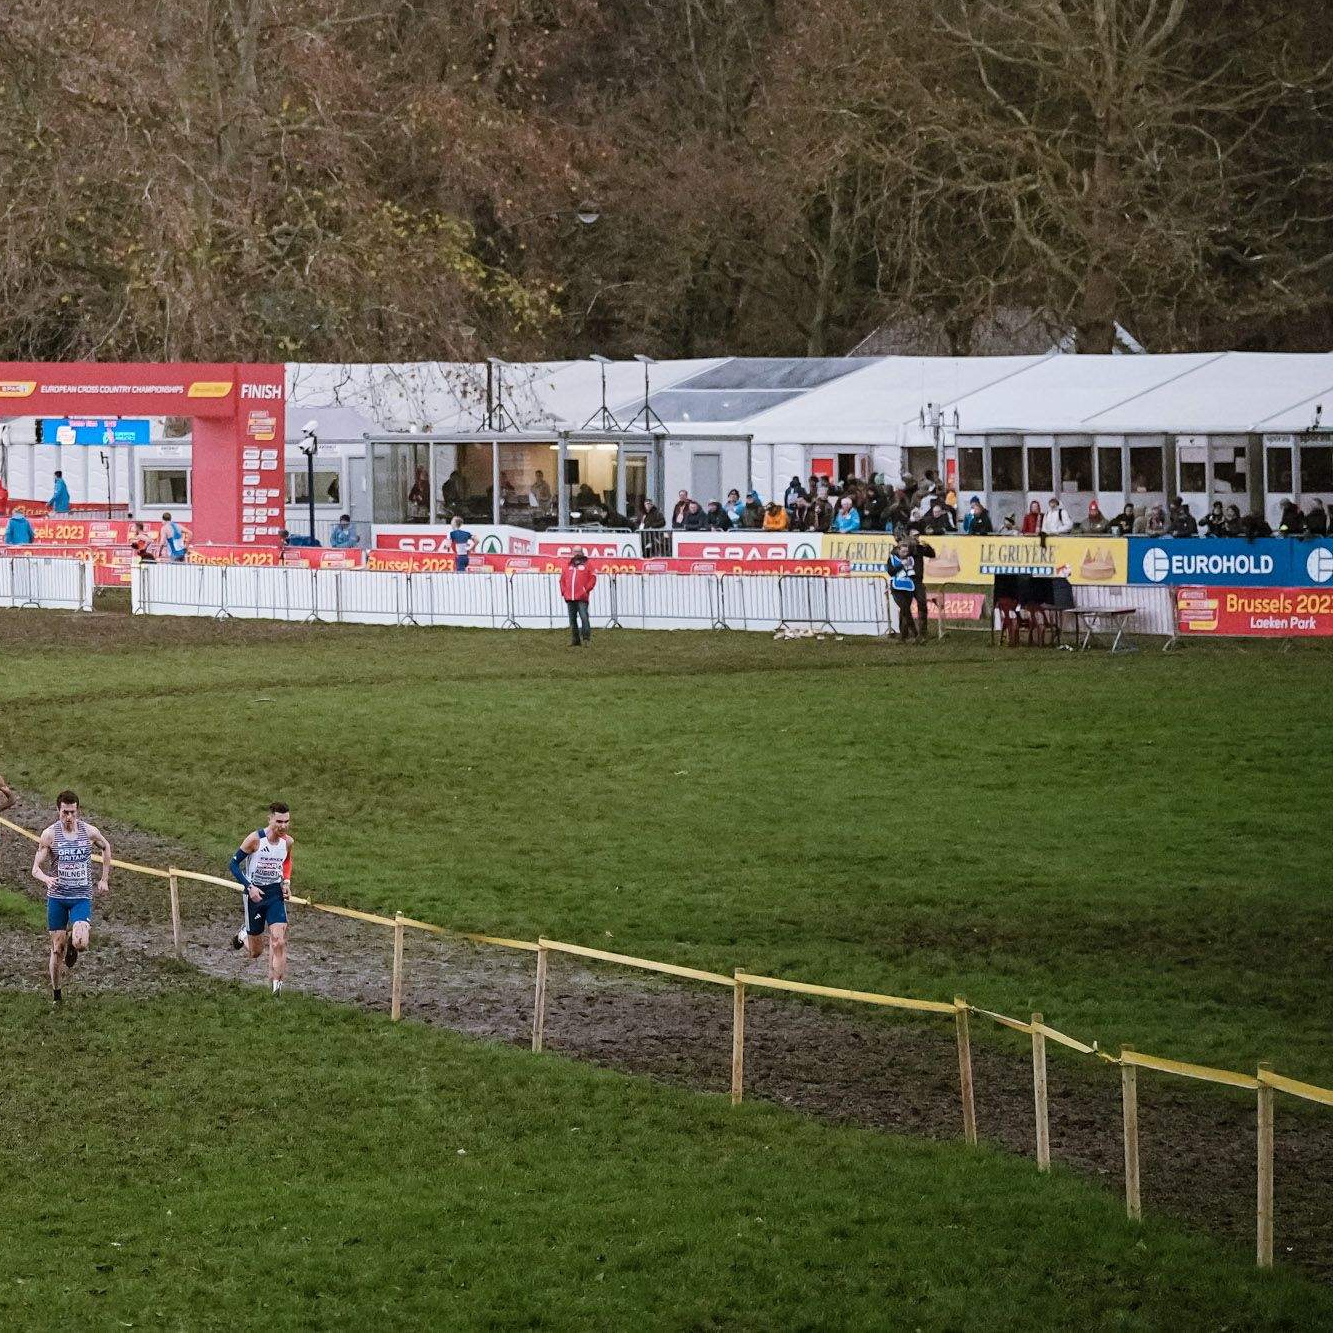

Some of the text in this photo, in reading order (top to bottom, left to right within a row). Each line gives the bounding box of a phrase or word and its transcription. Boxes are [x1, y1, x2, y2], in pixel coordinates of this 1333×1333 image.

[40, 385, 184, 395] EUROPEAN CROSS COUNTRY CHAMPIONSHIPS
[241, 383, 282, 399] FINISH
[55, 525, 84, 539] 2023
[242, 552, 274, 566] 2023
[981, 544, 997, 562] LE
[367, 551, 454, 572] Brussels 2023
[1171, 554, 1274, 574] EUROHOLD
[943, 599, 975, 614] 2023
[1226, 593, 1292, 614] Brussels
[1250, 616, 1317, 630] Laeken Park
[58, 870, 86, 878] MILNER
